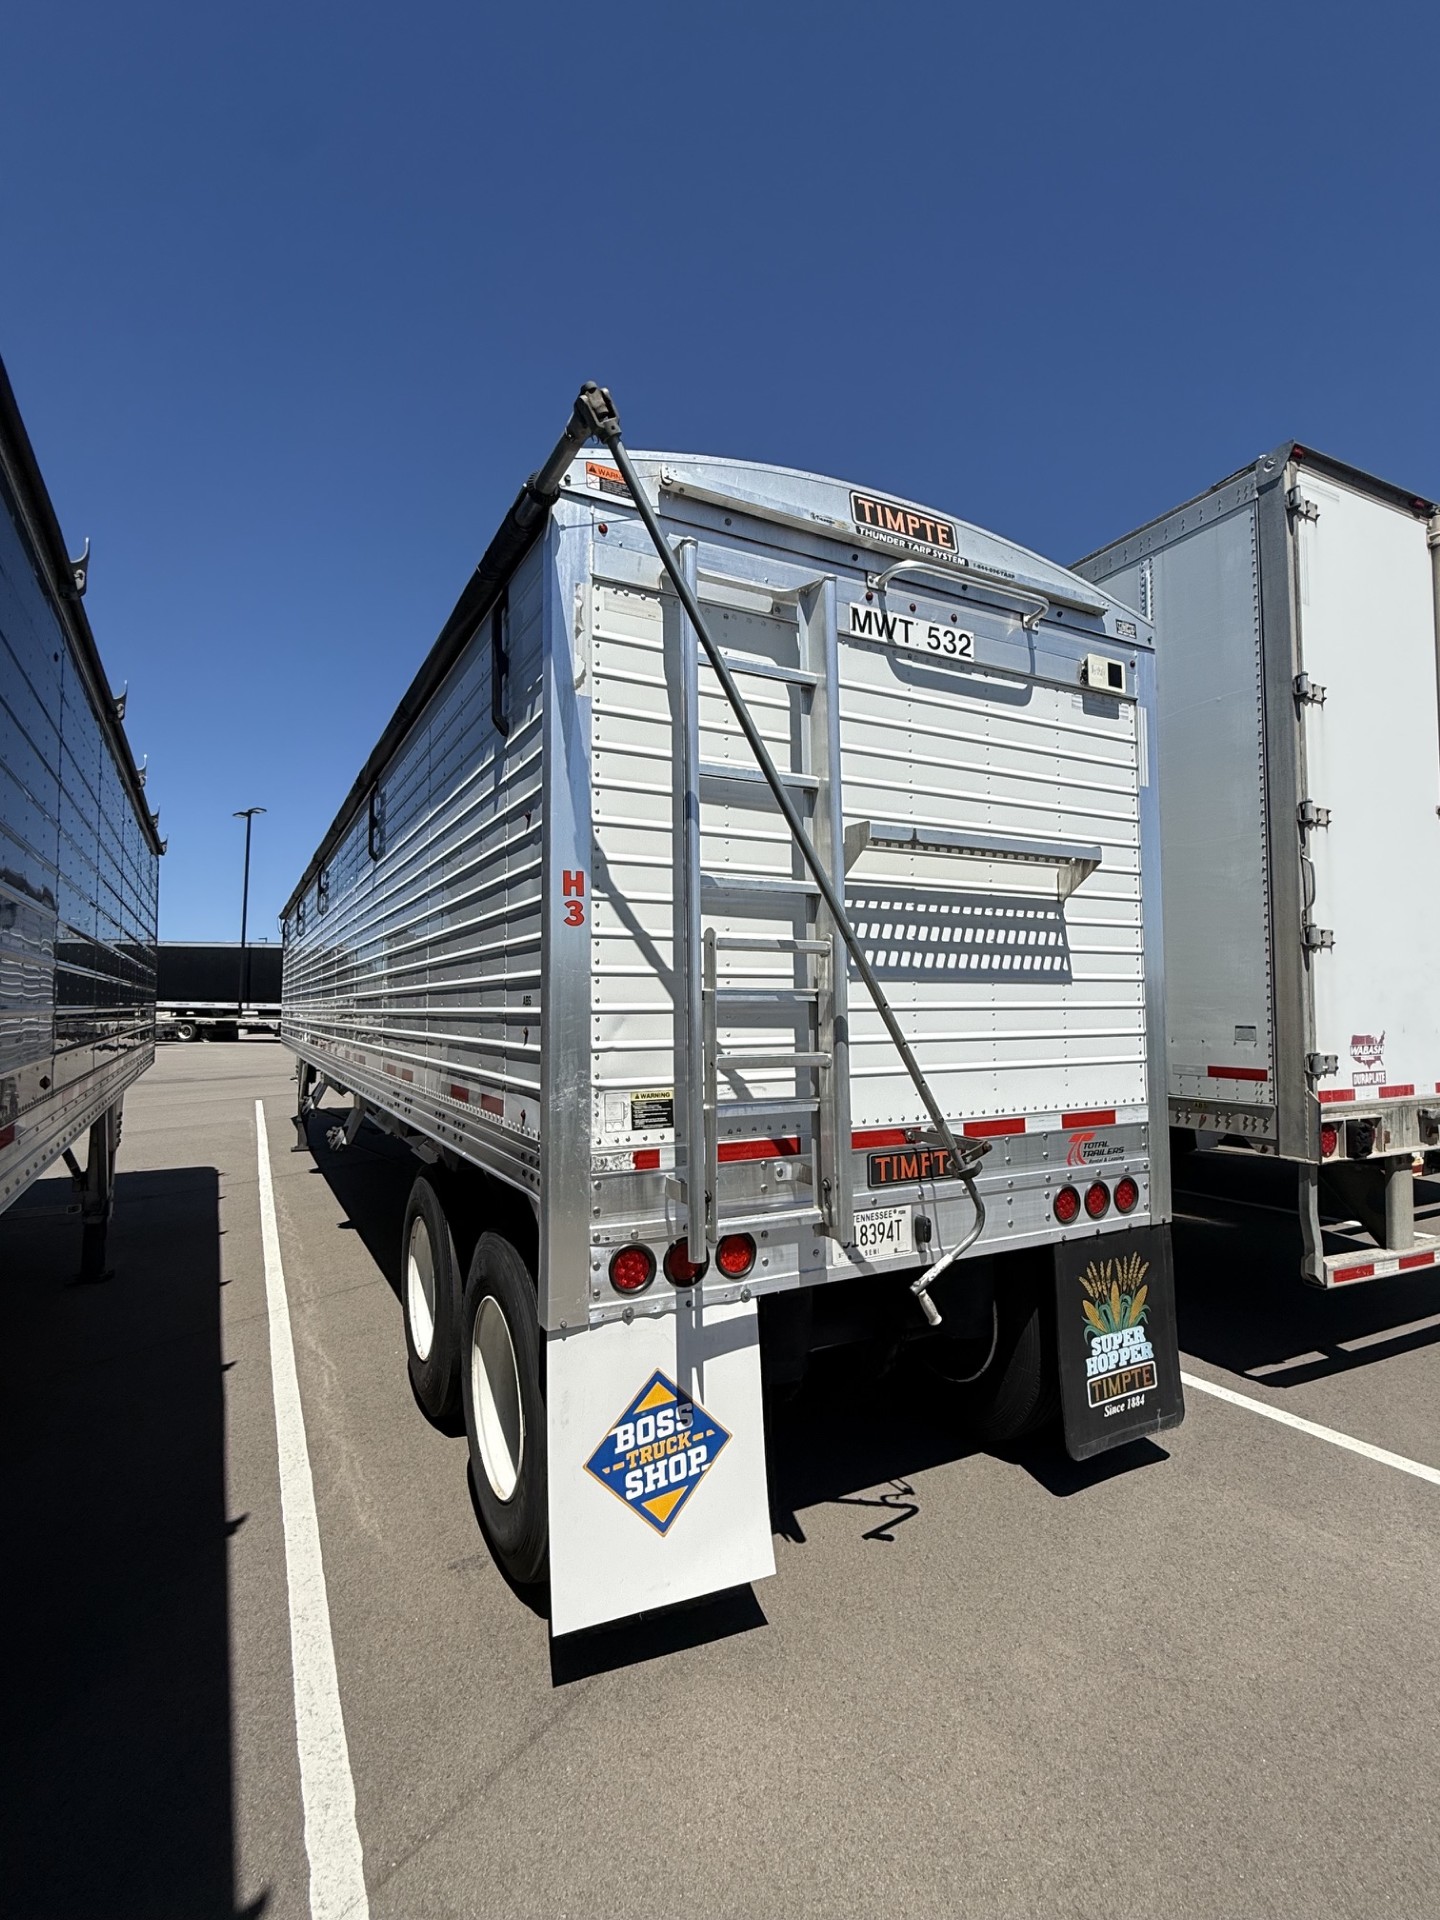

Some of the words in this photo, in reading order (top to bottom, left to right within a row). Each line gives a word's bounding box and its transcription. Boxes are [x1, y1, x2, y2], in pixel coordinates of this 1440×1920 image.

[858, 498, 951, 548] TIMPTE
[859, 527, 905, 548] THUNDER
[907, 542, 932, 555] TARP
[933, 549, 966, 566] SYSTEM
[850, 606, 914, 643] MWT
[927, 625, 972, 658] 532
[562, 870, 585, 897] H
[563, 900, 585, 926] 3
[1350, 1045, 1384, 1056] WABASH
[1353, 1072, 1385, 1086] DURAPLATE
[1083, 1141, 1109, 1149] TOTAL
[1083, 1146, 1125, 1158] TRAILERS
[874, 1150, 949, 1183] TIMPT
[843, 1219, 902, 1249] 18394T
[1091, 1325, 1146, 1356] SUPER
[1085, 1342, 1154, 1377] HOPPER
[1091, 1366, 1153, 1402] TIMPTE
[1103, 1403, 1126, 1418] Since
[1127, 1394, 1145, 1410] 1884
[608, 1402, 694, 1455] BOSS
[625, 1431, 692, 1469] TRUCK
[625, 1444, 712, 1501] SHOP
